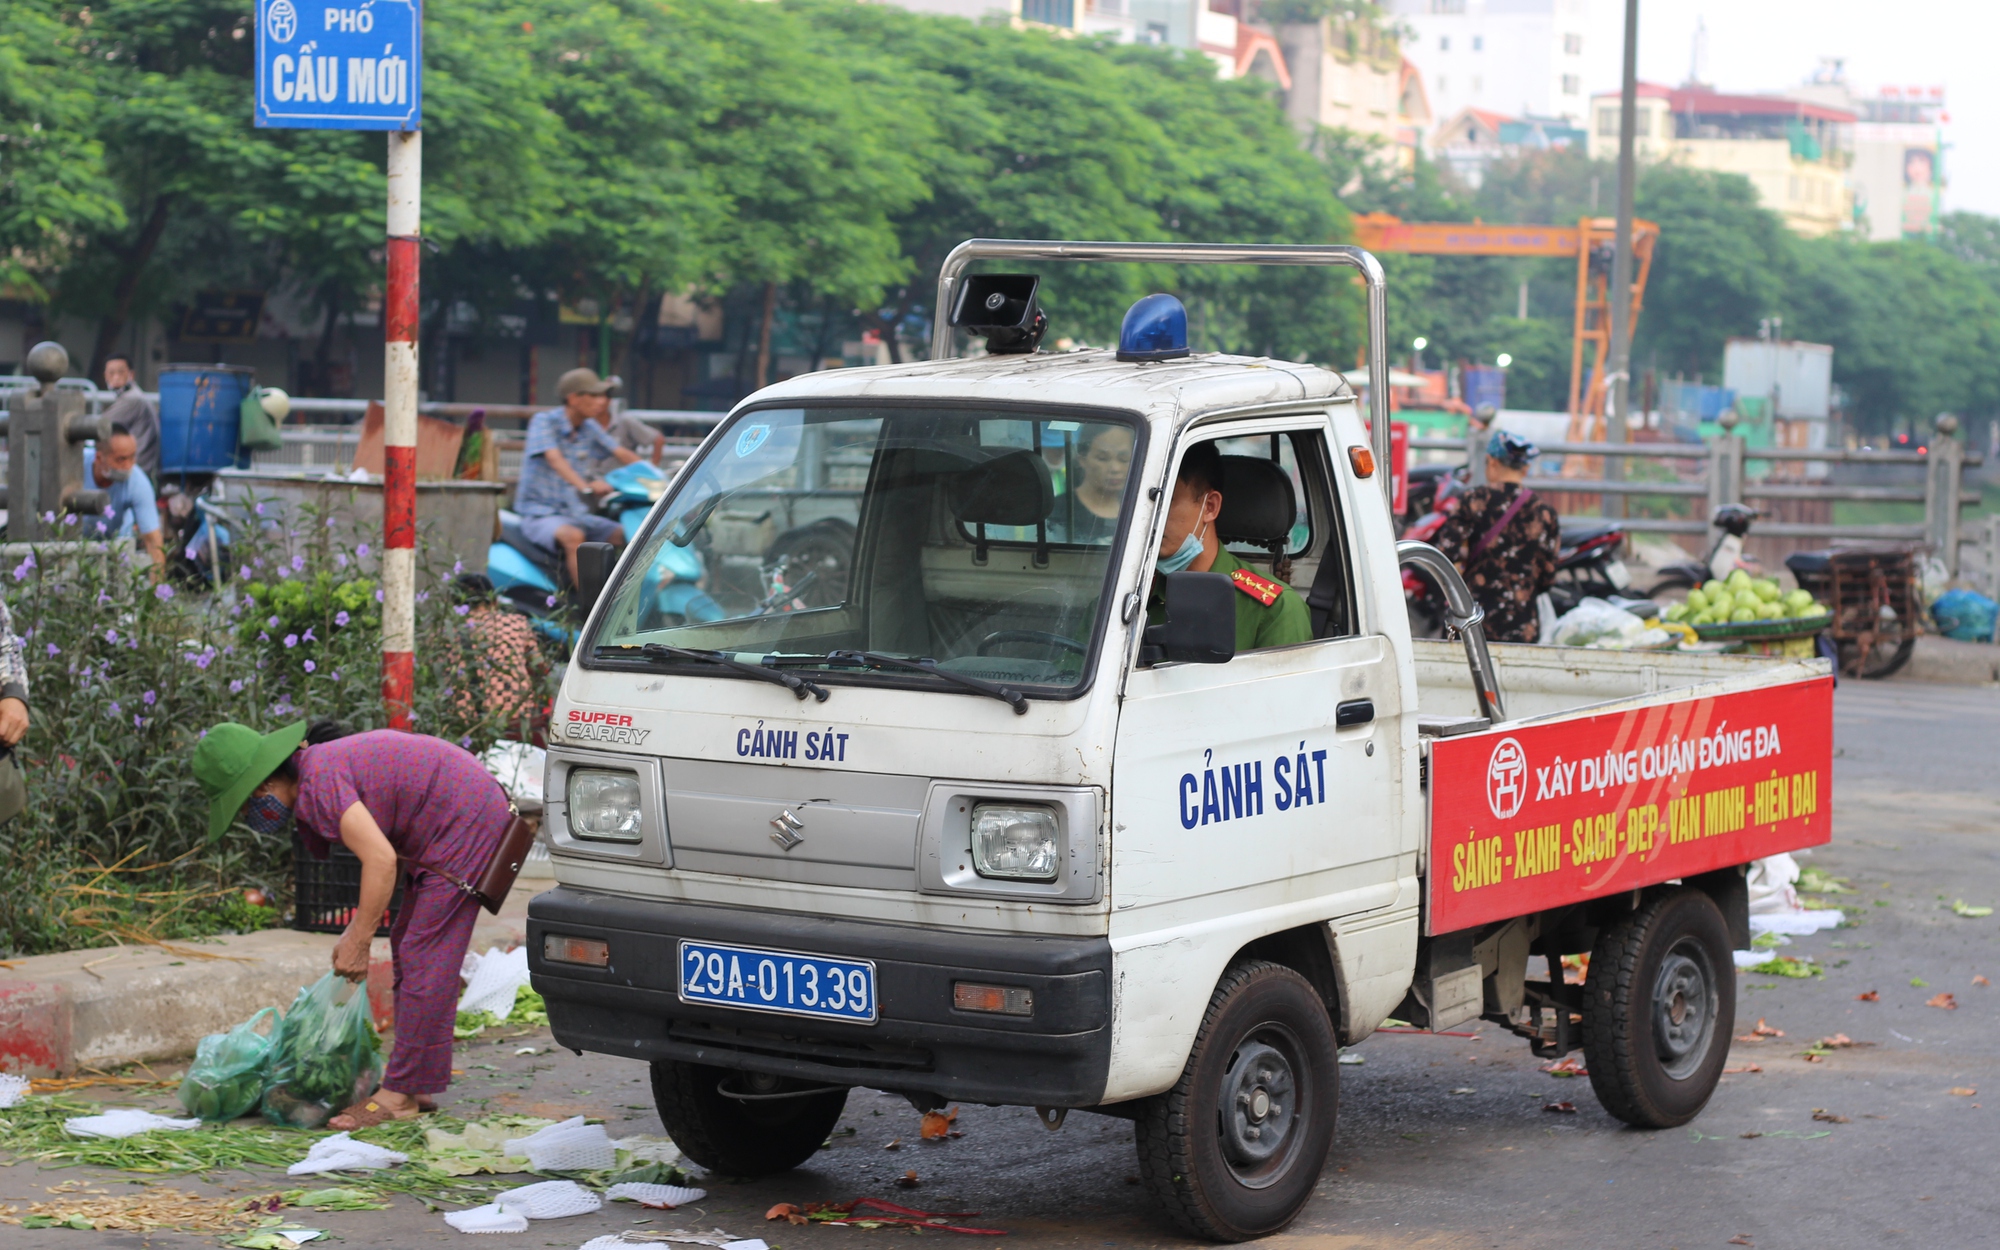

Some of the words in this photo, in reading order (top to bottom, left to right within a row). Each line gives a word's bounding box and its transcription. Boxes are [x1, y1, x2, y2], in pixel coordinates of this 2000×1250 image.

[324, 0, 375, 33] PHỐ
[272, 40, 338, 103] CẦU
[347, 43, 407, 105] MỚI
[565, 722, 650, 745] CARRY
[568, 710, 633, 727] SUPER
[736, 719, 798, 759] CẢNH
[804, 727, 849, 762] SÁT
[1179, 748, 1263, 830] CẢNH
[1274, 740, 1327, 811] SÁT
[1535, 755, 1578, 802] XÂY
[1580, 750, 1637, 798] DỰNG
[1641, 734, 1695, 783] QUẬN
[1699, 720, 1751, 770] ĐỐNG
[1754, 724, 1781, 759] ĐA
[1453, 830, 1502, 893] SÁNG
[1513, 823, 1561, 880] XANH
[1572, 812, 1617, 875] SẠCH
[1627, 803, 1659, 863] ĐẸP
[1669, 787, 1701, 845] VĂN
[1704, 785, 1746, 838] MINH
[1754, 769, 1790, 833] HIỆN
[1792, 770, 1817, 826] ĐẠI
[687, 950, 868, 1014] 29A-013.39
